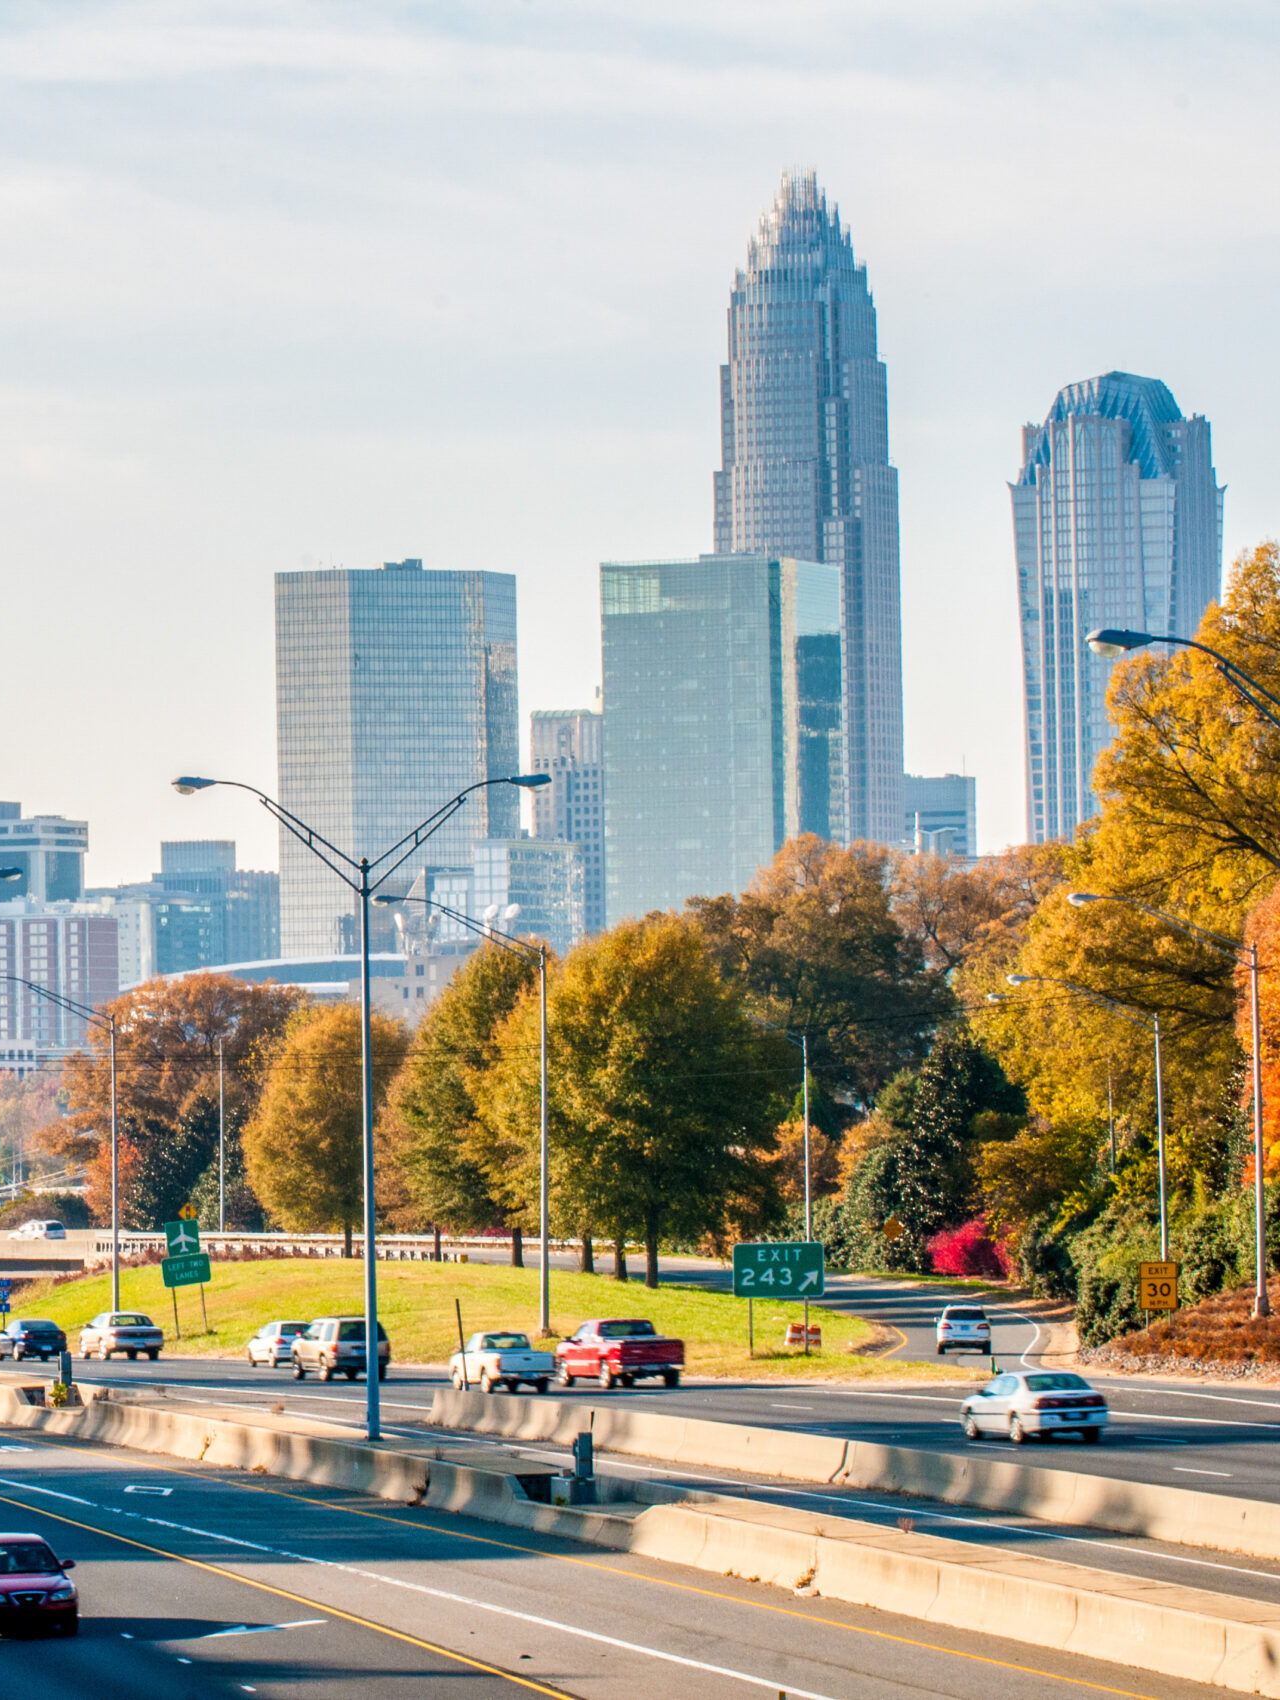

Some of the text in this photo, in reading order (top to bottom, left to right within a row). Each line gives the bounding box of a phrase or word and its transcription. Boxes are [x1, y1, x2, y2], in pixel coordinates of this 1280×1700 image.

[757, 1249, 802, 1261] EXIT
[167, 1263, 185, 1271] LEFT
[1148, 1267, 1168, 1275] EXIT
[176, 1270, 199, 1280] LANES
[741, 1268, 792, 1285] 243
[1147, 1282, 1171, 1297] 30
